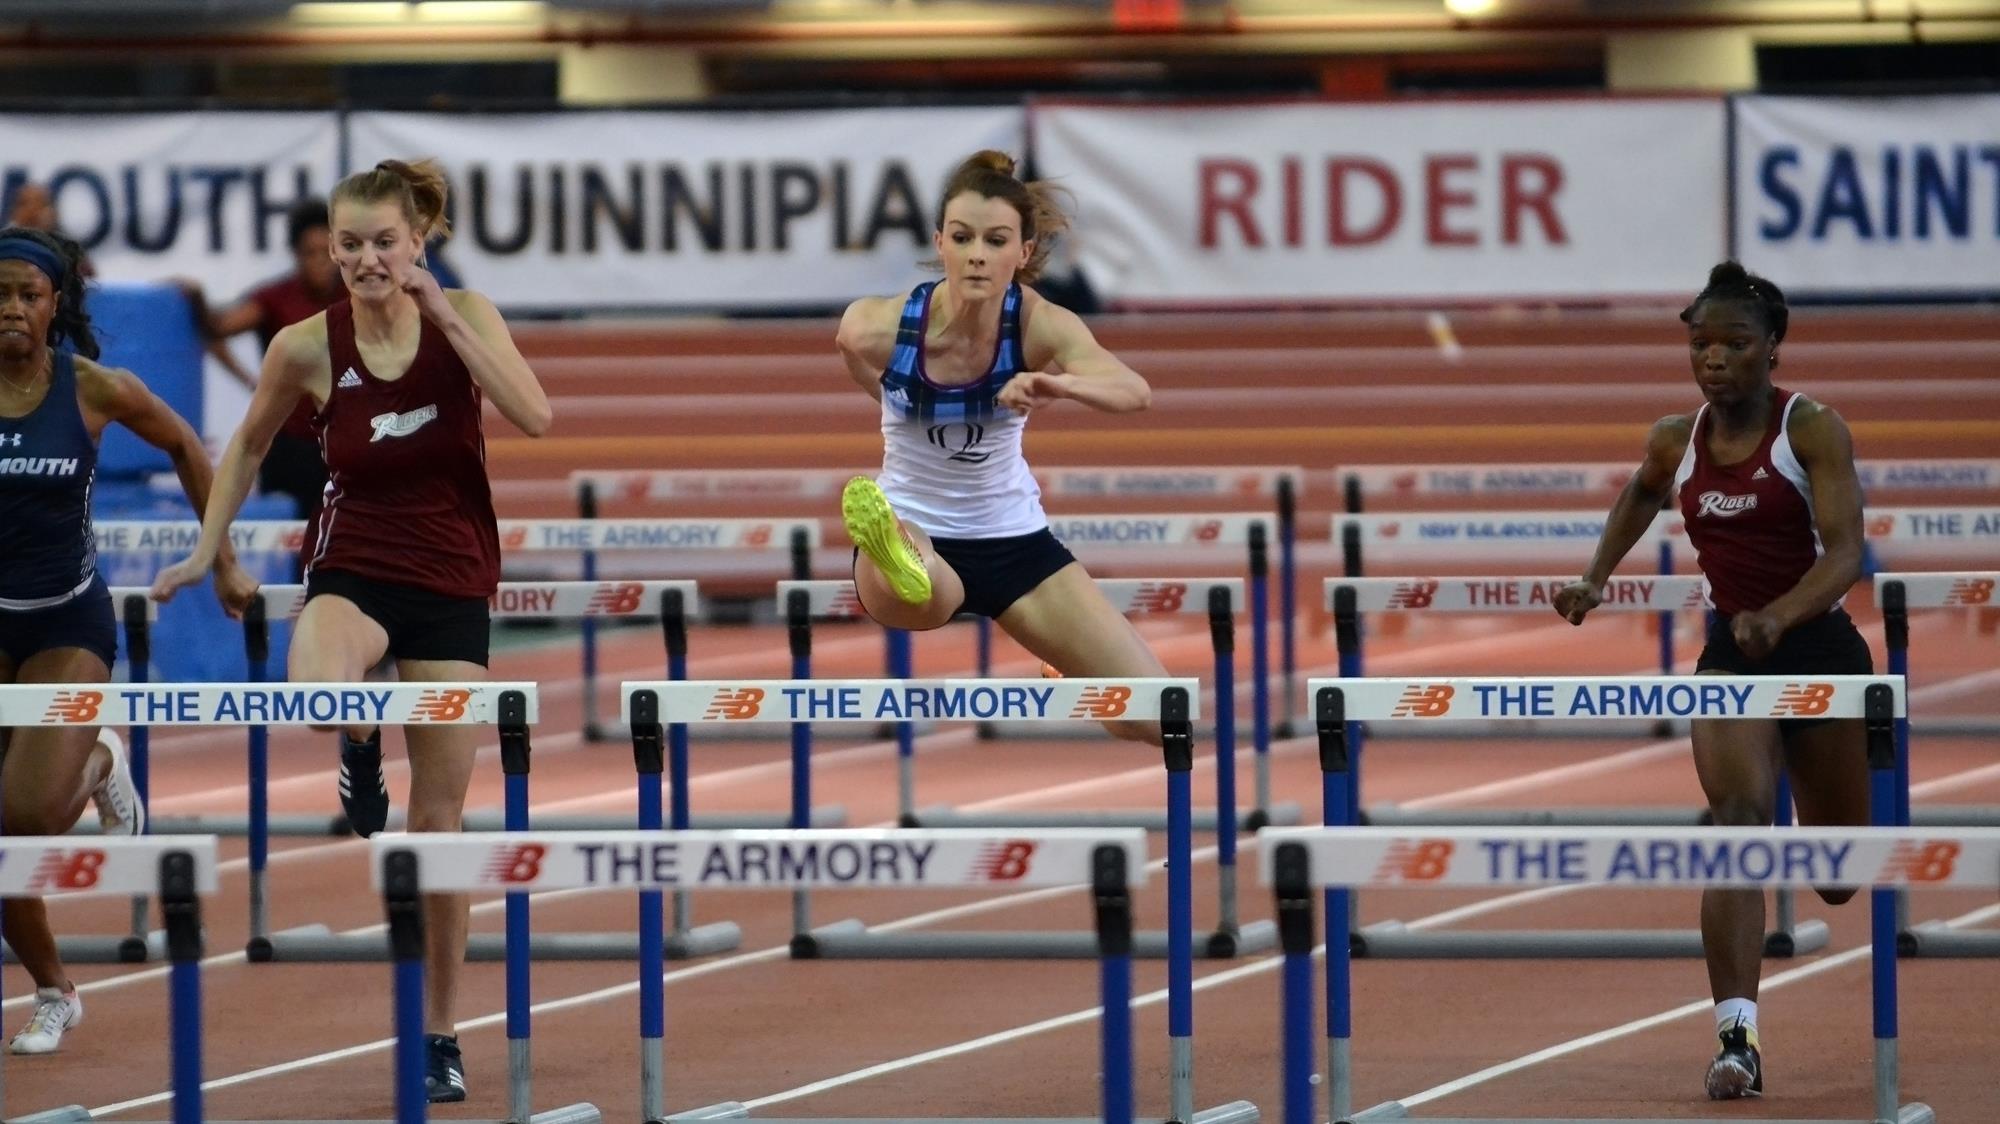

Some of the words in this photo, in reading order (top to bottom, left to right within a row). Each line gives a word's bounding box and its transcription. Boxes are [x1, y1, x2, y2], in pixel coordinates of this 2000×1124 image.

[444, 161, 945, 255] UINNIPIA
[1195, 152, 1569, 250] RIDER
[94, 527, 128, 548] HE
[138, 527, 257, 547] ARMY
[542, 526, 590, 547] THE
[603, 525, 720, 546] ARMORY
[1053, 520, 1169, 541] ARMORY
[1550, 522, 1604, 537] NATIO
[1909, 514, 1962, 536] THE
[488, 588, 557, 612] ORY
[1465, 581, 1520, 604] THE
[1528, 580, 1655, 604] ARORY
[41, 691, 103, 723] NB
[121, 691, 200, 722] THE
[213, 690, 393, 721] ARMORY
[407, 689, 471, 721] NB
[702, 688, 765, 720] NB
[782, 688, 861, 719] THE
[875, 686, 1054, 719] ARMORY
[1069, 686, 1132, 718] NB
[1391, 685, 1455, 717] NB
[1472, 685, 1554, 716] THE
[1568, 684, 1755, 716] ARMORY
[1769, 683, 1835, 716] NB
[576, 843, 678, 883] THE
[700, 841, 936, 883] ARMORY
[1478, 839, 1589, 881] THE
[1606, 838, 1854, 882] ARMORY
